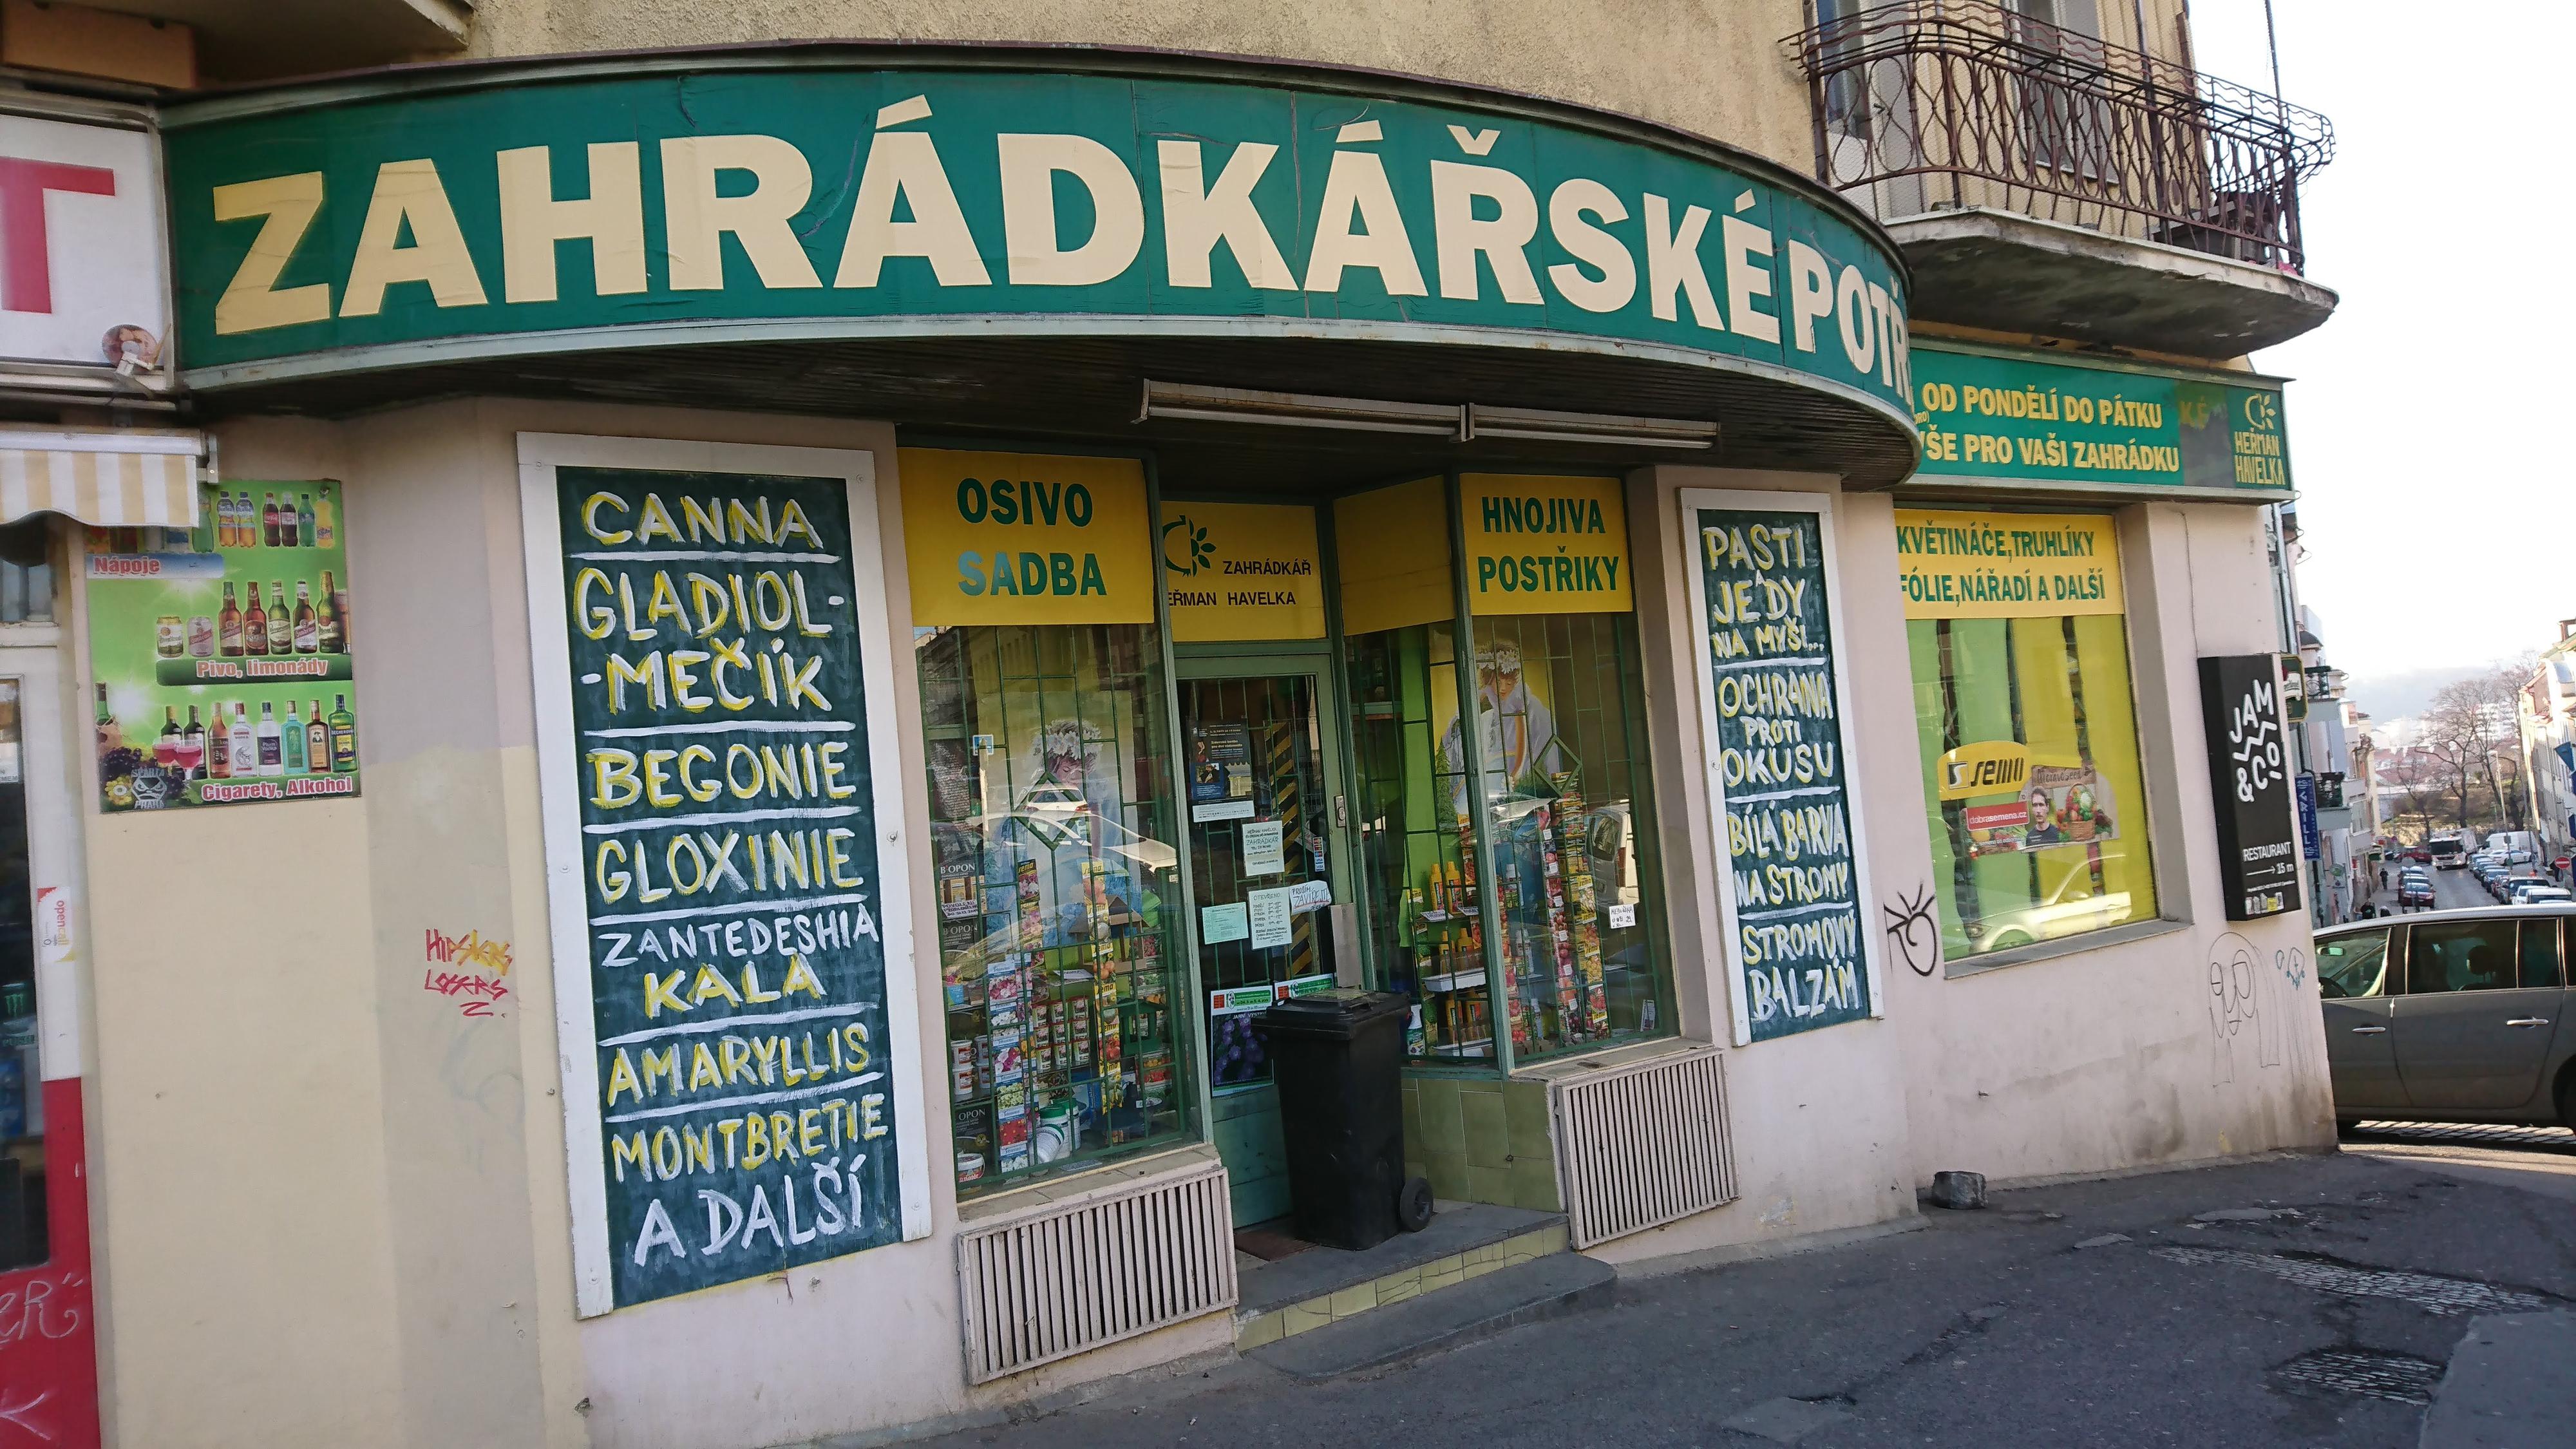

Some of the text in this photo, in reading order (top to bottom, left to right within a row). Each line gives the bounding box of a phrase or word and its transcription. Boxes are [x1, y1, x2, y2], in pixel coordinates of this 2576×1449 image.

[213, 94, 1912, 411] ZAHRÁDKÁŘSKÉ POTŘ
[1922, 382, 2163, 428] OD PONDĚLÍ DO PÁTKU
[1964, 434, 2013, 464] PRO
[2018, 432, 2069, 467] VAŠI
[2072, 438, 2180, 472] ZAHRÁDKU
[2234, 455, 2286, 485] HAVELKA
[581, 491, 824, 549] CANNA
[957, 478, 1094, 527] OSIVO
[1481, 496, 1606, 534] HNOJIVA
[93, 555, 161, 576] Nápoje
[1222, 558, 1311, 576] ZAHRÁDKÁŘ
[1478, 545, 1620, 593] POSTŘIKY
[1702, 524, 1806, 571] PASTI
[958, 551, 1107, 596] SADBA
[1755, 569, 1766, 587] A
[2038, 575, 2051, 601] A
[2054, 567, 2106, 600] DALŠÍ
[1168, 589, 1296, 607] EŘMAN HAVELKA
[1712, 575, 1806, 624] JEDY
[1712, 629, 1750, 659] NA
[196, 658, 329, 678] Pivo, limonády
[1719, 669, 1834, 720] OCHRANA
[2228, 679, 2275, 744] JAM
[1740, 716, 1802, 747] PROTI
[202, 776, 353, 801] Cigarety, Alkohol
[585, 742, 857, 810] BEGONIE
[1720, 743, 1834, 788] OKUSU
[1971, 757, 2025, 787] semo
[1727, 800, 1849, 861] BÍLÁ BARVA
[1969, 811, 2027, 825] dobrasemena.cz
[595, 828, 865, 904] GLOXINIE
[2242, 841, 2291, 862] RESTAURANT
[2276, 862, 2286, 875] 15
[1733, 861, 1848, 908] NA STROMY
[1088, 904, 1106, 914] smo
[598, 904, 880, 967] ZANTEDESHIA
[1743, 909, 1857, 965] STROMOVÝ
[644, 951, 827, 1019] KALA
[1748, 957, 1860, 1022] BALZÁM
[607, 1022, 869, 1108] AMARYLLIS
[611, 1093, 888, 1183] MONTBRETIE
[634, 1154, 867, 1267] A DALŠÍ
